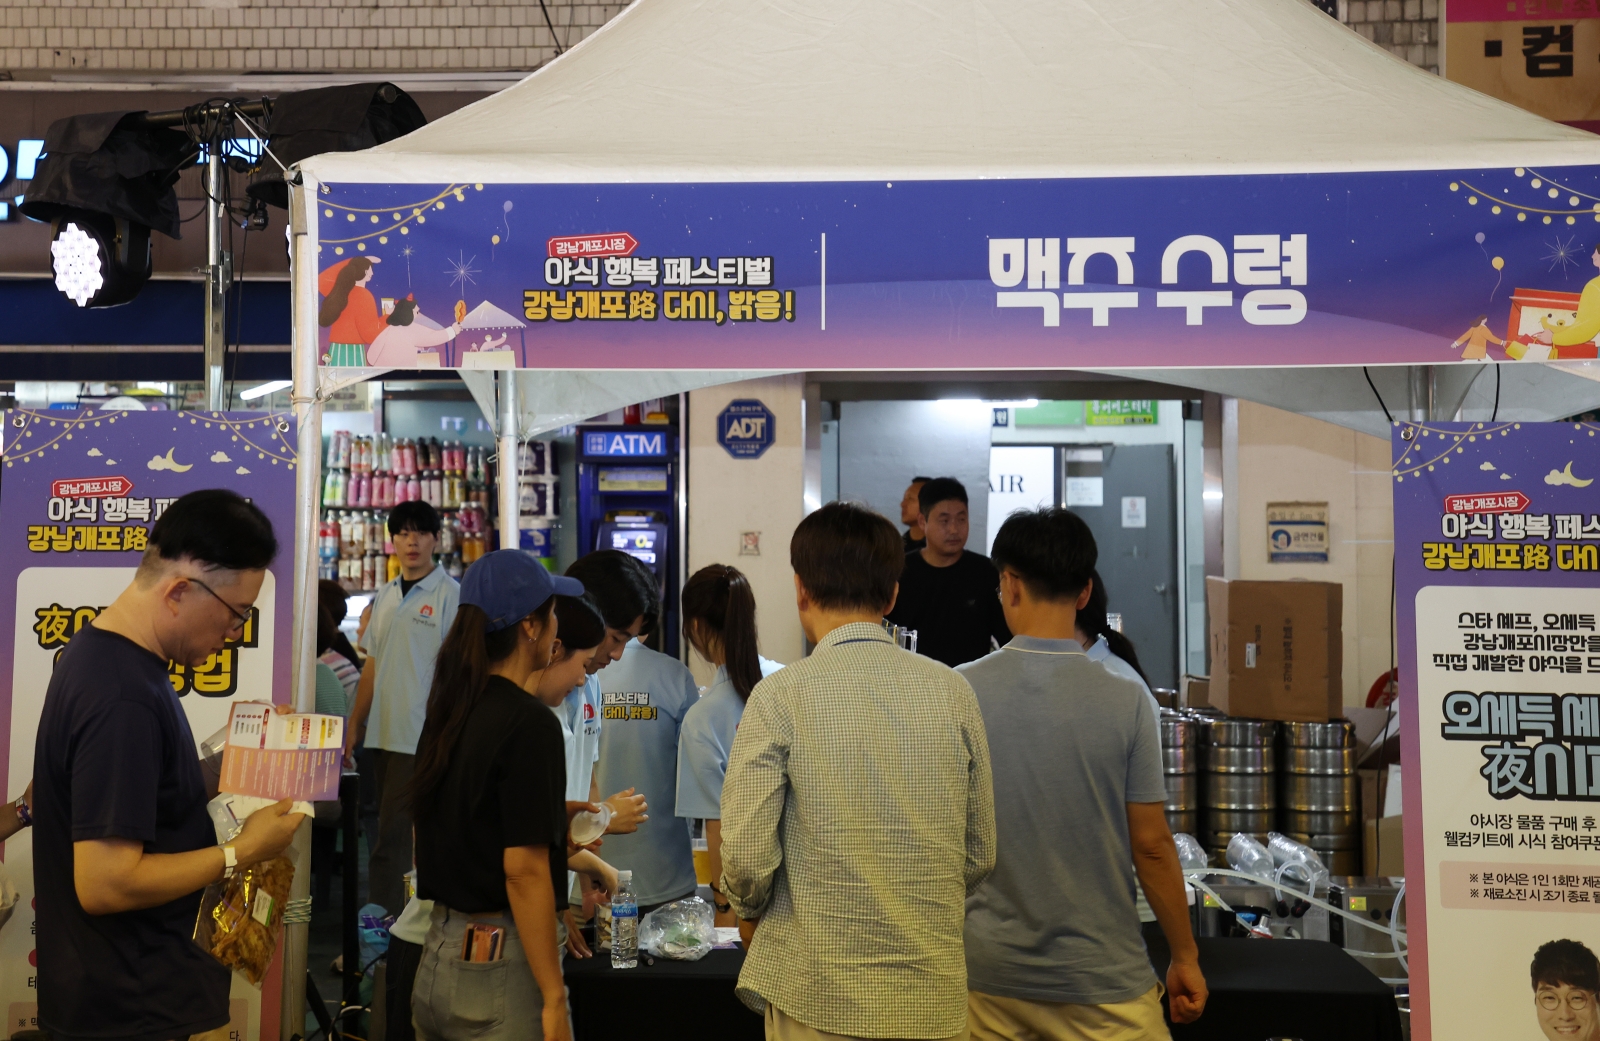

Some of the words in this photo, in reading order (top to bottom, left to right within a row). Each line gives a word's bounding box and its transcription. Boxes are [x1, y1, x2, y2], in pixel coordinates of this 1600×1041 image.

[556, 238, 625, 254] 강남개포시장
[545, 257, 599, 286] 야식
[604, 257, 659, 286] 행복
[663, 257, 772, 286] 페스티벌
[989, 237, 1138, 327] 맥주
[1157, 233, 1308, 326] 수령
[524, 290, 656, 320] 강남개포路
[663, 290, 725, 325] 다시,
[728, 290, 794, 321] 밝음!
[726, 417, 766, 439] ADT
[609, 434, 662, 455] ATM
[59, 480, 122, 495] 강남개포시장
[48, 498, 98, 522] 야식
[103, 498, 151, 522] 행복
[1452, 496, 1518, 511] 강남개포시장
[1442, 513, 1494, 540] 야식
[1499, 513, 1551, 540] 행복
[28, 526, 148, 551] 강남개포路
[1423, 543, 1550, 570] 강남개포路
[1458, 612, 1493, 629] 스타
[1543, 613, 1596, 632] 오세득
[1463, 633, 1600, 652] 강남개포시장만을
[1433, 654, 1468, 671] 직접
[1472, 655, 1525, 672] 개발한
[1529, 656, 1582, 673] 야식을
[604, 692, 649, 705] 페스티벌
[1442, 692, 1557, 739] 오세득
[1470, 813, 1513, 830] 야시장
[1516, 815, 1545, 831] 물품
[1549, 815, 1578, 831] 구매
[1582, 816, 1597, 832] 후
[1444, 831, 1514, 848] 웰컴키트에
[1518, 834, 1546, 849] 시식
[1482, 872, 1494, 884] 본
[1496, 873, 1529, 886] 야식은
[1532, 874, 1549, 886] 1인
[1552, 875, 1580, 888] 1회만
[1483, 888, 1527, 901] 재료소진
[1529, 889, 1540, 902] 시
[1543, 890, 1565, 903] 조기
[1567, 891, 1590, 904] 종료
